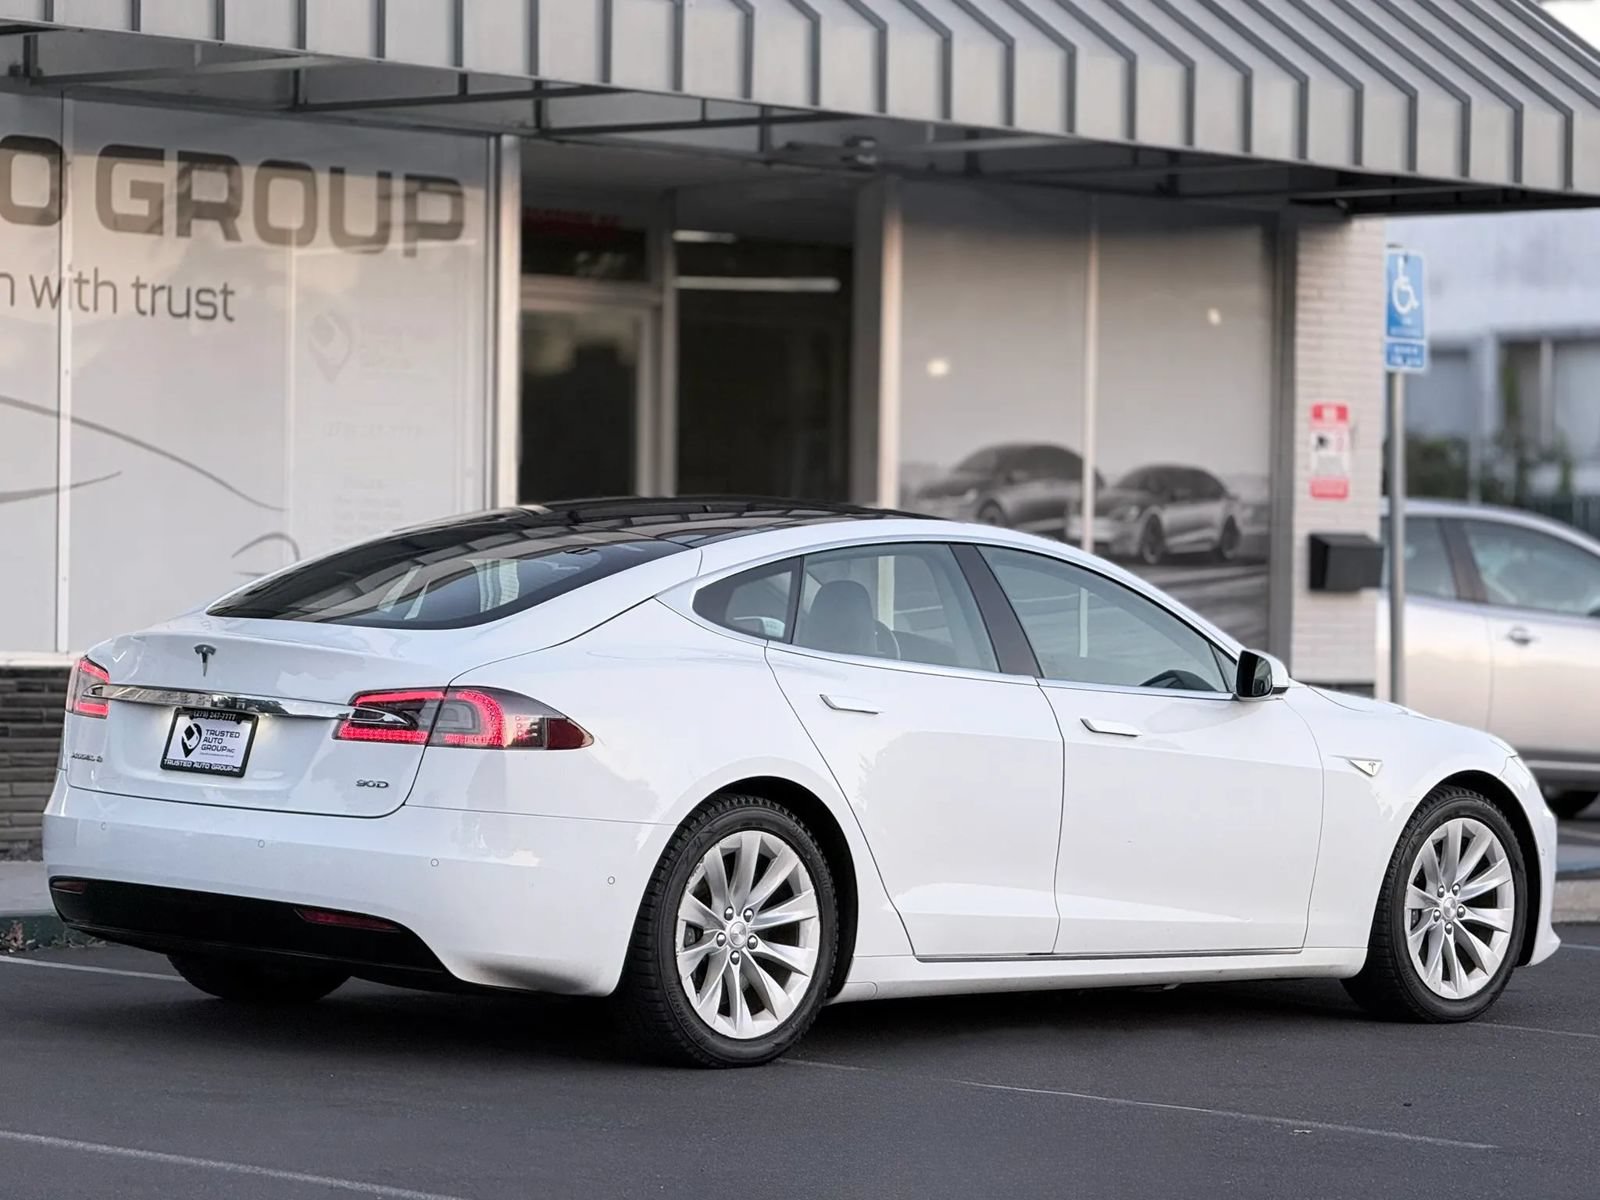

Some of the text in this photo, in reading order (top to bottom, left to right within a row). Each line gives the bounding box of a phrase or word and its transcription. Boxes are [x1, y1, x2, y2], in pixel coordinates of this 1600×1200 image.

[95, 143, 466, 258] GROUP
[28, 264, 118, 314] with
[130, 275, 236, 323] trust
[205, 729, 241, 739] TRUSTED
[202, 736, 224, 745] AUTO
[200, 743, 228, 752] GROUP
[163, 758, 193, 768] TRUSTED
[193, 761, 211, 769] AUTO
[211, 763, 233, 772] GROUP
[356, 779, 390, 789] 90D
